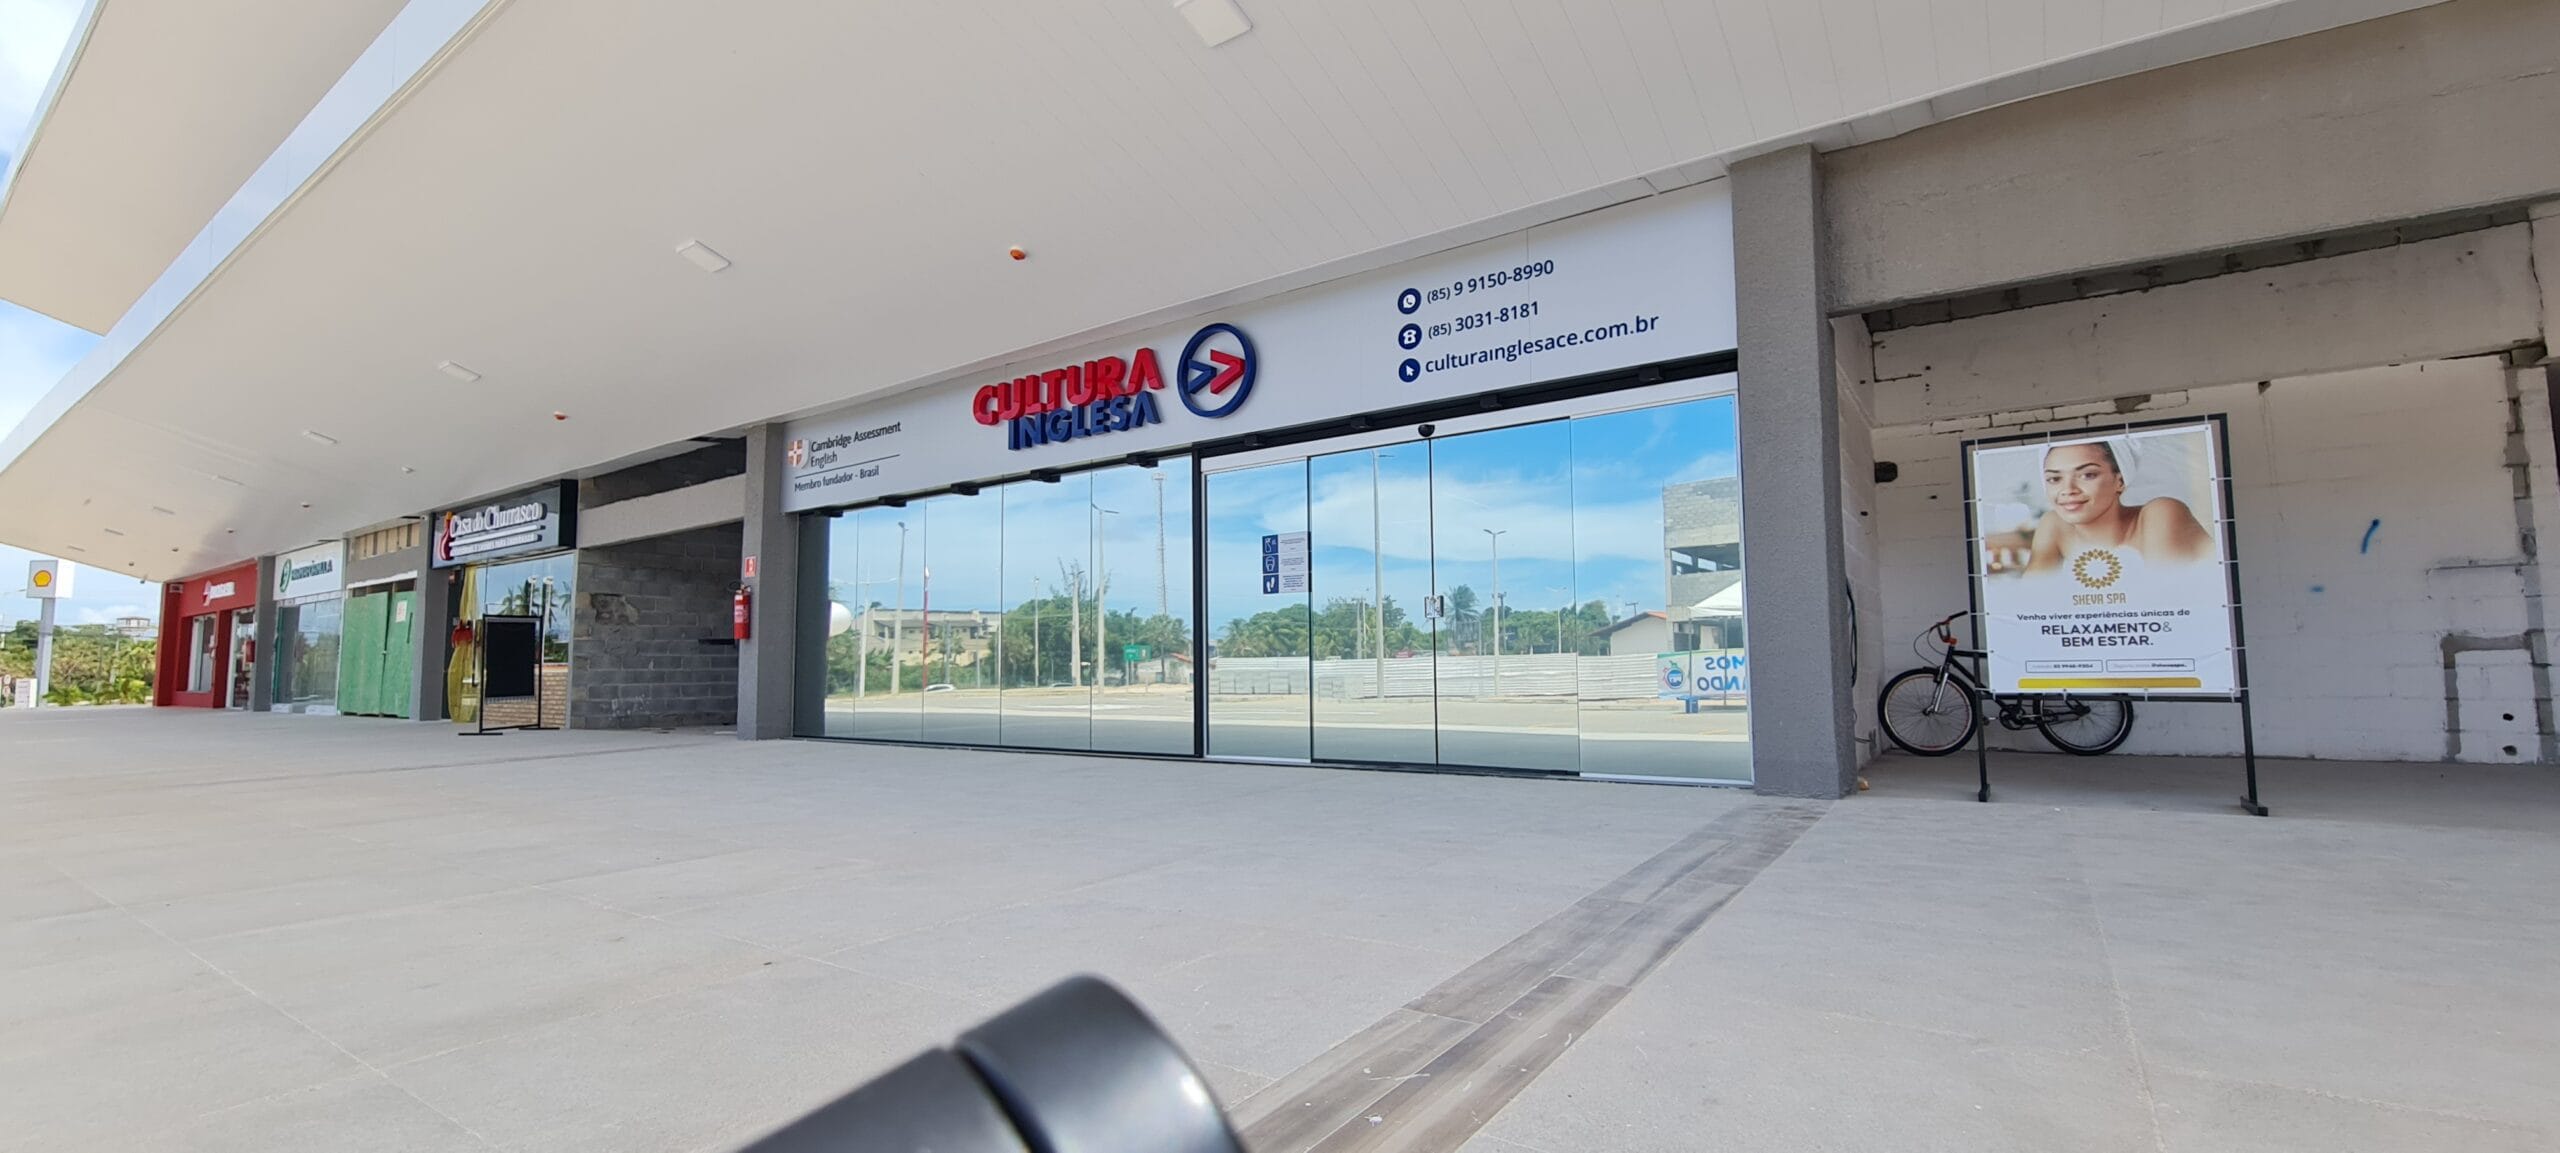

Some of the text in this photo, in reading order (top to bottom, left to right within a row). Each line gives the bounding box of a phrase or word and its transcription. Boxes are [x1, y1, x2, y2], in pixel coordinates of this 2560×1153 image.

[1427, 259, 1554, 304] (85) 9 9150-8990
[1428, 301, 1538, 339] (85) 3031-8181
[1425, 314, 1660, 373] culturainglesace.com.br
[973, 347, 1165, 425] CULTURA
[1008, 391, 1161, 450] INGLESA
[811, 421, 901, 452] Cambridge Assessment
[810, 451, 838, 469] English
[794, 479, 822, 492] Membro
[822, 472, 853, 486] fundador
[859, 465, 880, 479] Brasil
[2016, 613, 2047, 621] Venha
[2074, 609, 2139, 620] experiências
[2140, 609, 2175, 617] únicas
[2176, 608, 2190, 616] de
[2072, 592, 2127, 606] SHEVA SPA
[2061, 635, 2154, 647] BEM ESTAR.
